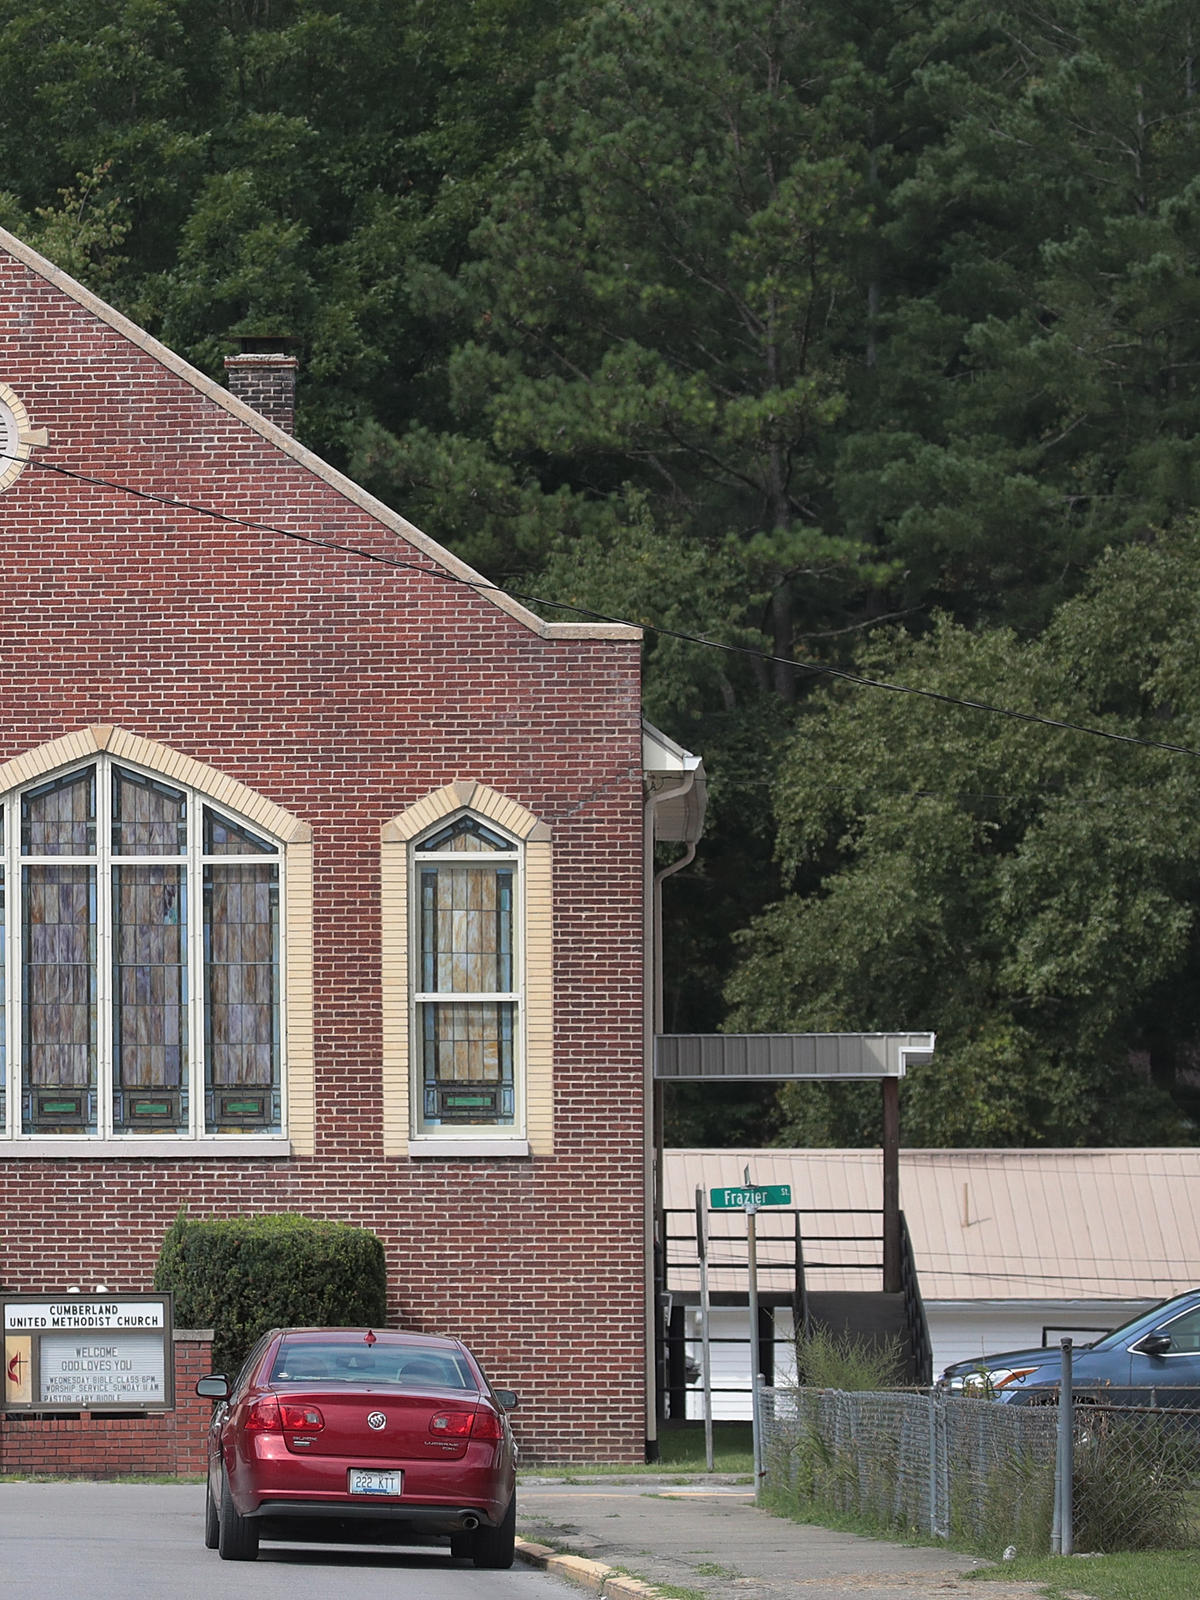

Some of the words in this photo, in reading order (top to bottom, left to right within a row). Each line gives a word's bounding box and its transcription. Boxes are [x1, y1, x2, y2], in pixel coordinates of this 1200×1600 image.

[724, 1190, 767, 1205] Frazier
[50, 1305, 118, 1315] CUMBERLAND
[10, 1317, 47, 1327] UNITED
[52, 1316, 111, 1327] METHODIST
[117, 1316, 158, 1326] CHURCH
[76, 1346, 118, 1358] WELCOME
[61, 1360, 79, 1371] GOD
[81, 1360, 112, 1371] LOVES
[114, 1360, 132, 1371] YOU
[49, 1376, 89, 1384] WEDNESDAY
[93, 1376, 113, 1384] BIBLE
[46, 1384, 76, 1393] WORSHIP
[80, 1384, 108, 1392] SERVICE
[113, 1383, 140, 1392] SUNDAY
[44, 1394, 72, 1402] PASTOR
[355, 1476, 373, 1488] 222
[378, 1477, 395, 1489] KTT
